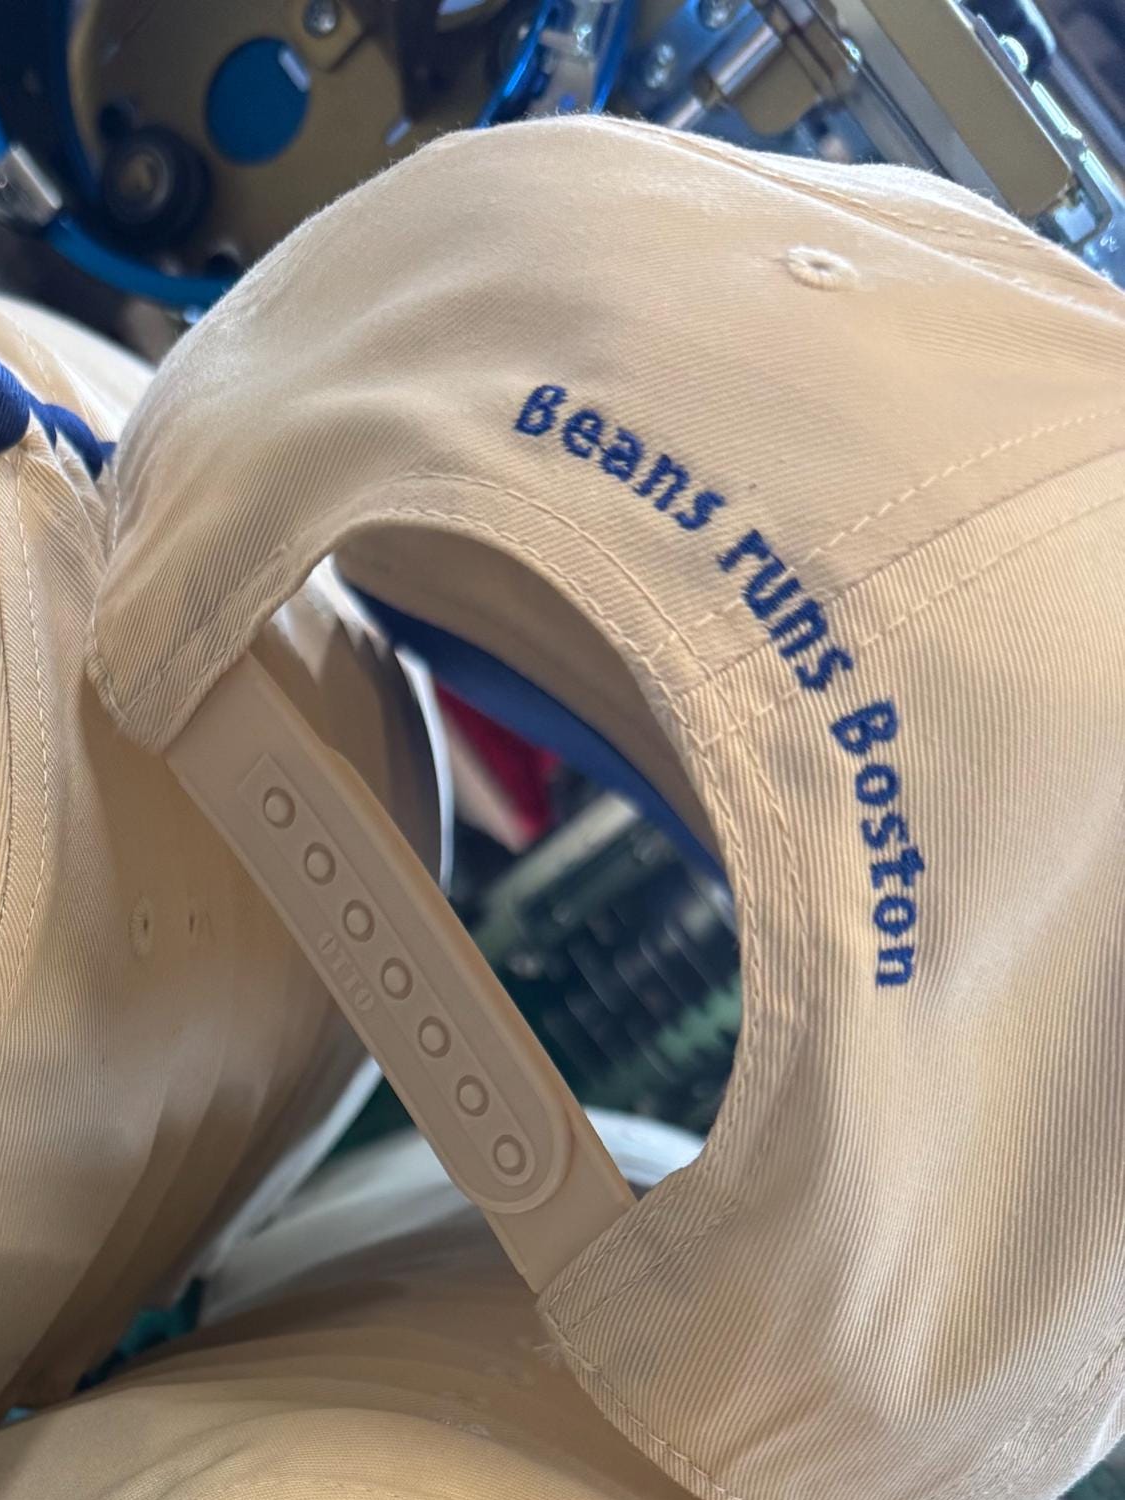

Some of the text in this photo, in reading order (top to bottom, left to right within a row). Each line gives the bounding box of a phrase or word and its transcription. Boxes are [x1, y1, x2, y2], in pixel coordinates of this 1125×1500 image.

[513, 383, 925, 988] Beans runs Boston
